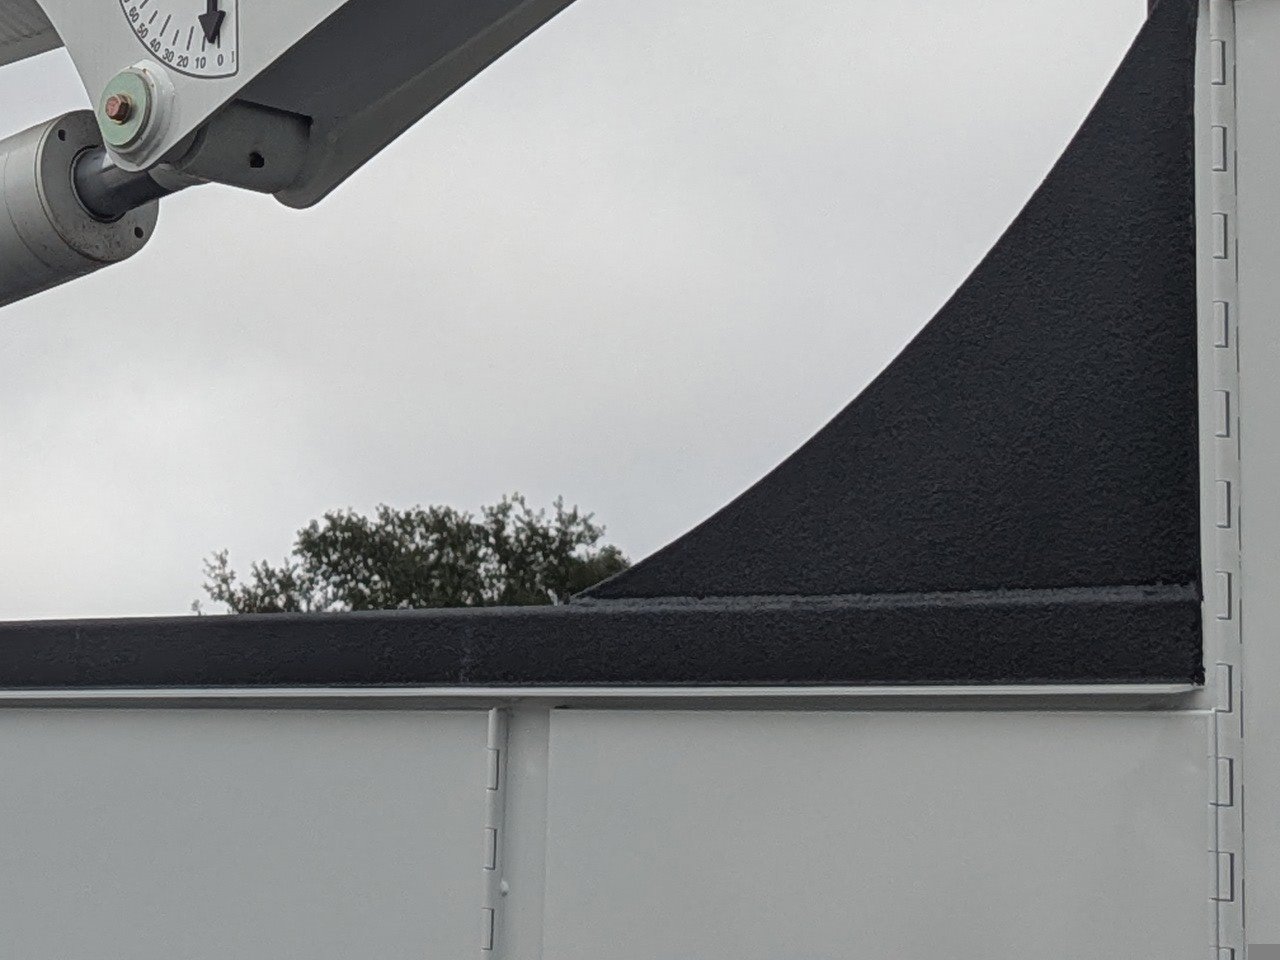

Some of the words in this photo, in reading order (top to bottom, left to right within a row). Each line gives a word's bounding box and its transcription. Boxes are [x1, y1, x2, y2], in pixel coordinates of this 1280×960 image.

[129, 6, 140, 23] 60
[137, 23, 149, 39] 50
[150, 38, 161, 52] 40
[162, 48, 175, 63] 30
[177, 55, 189, 68] 20
[195, 56, 206, 69] 10
[217, 54, 224, 66] 0
